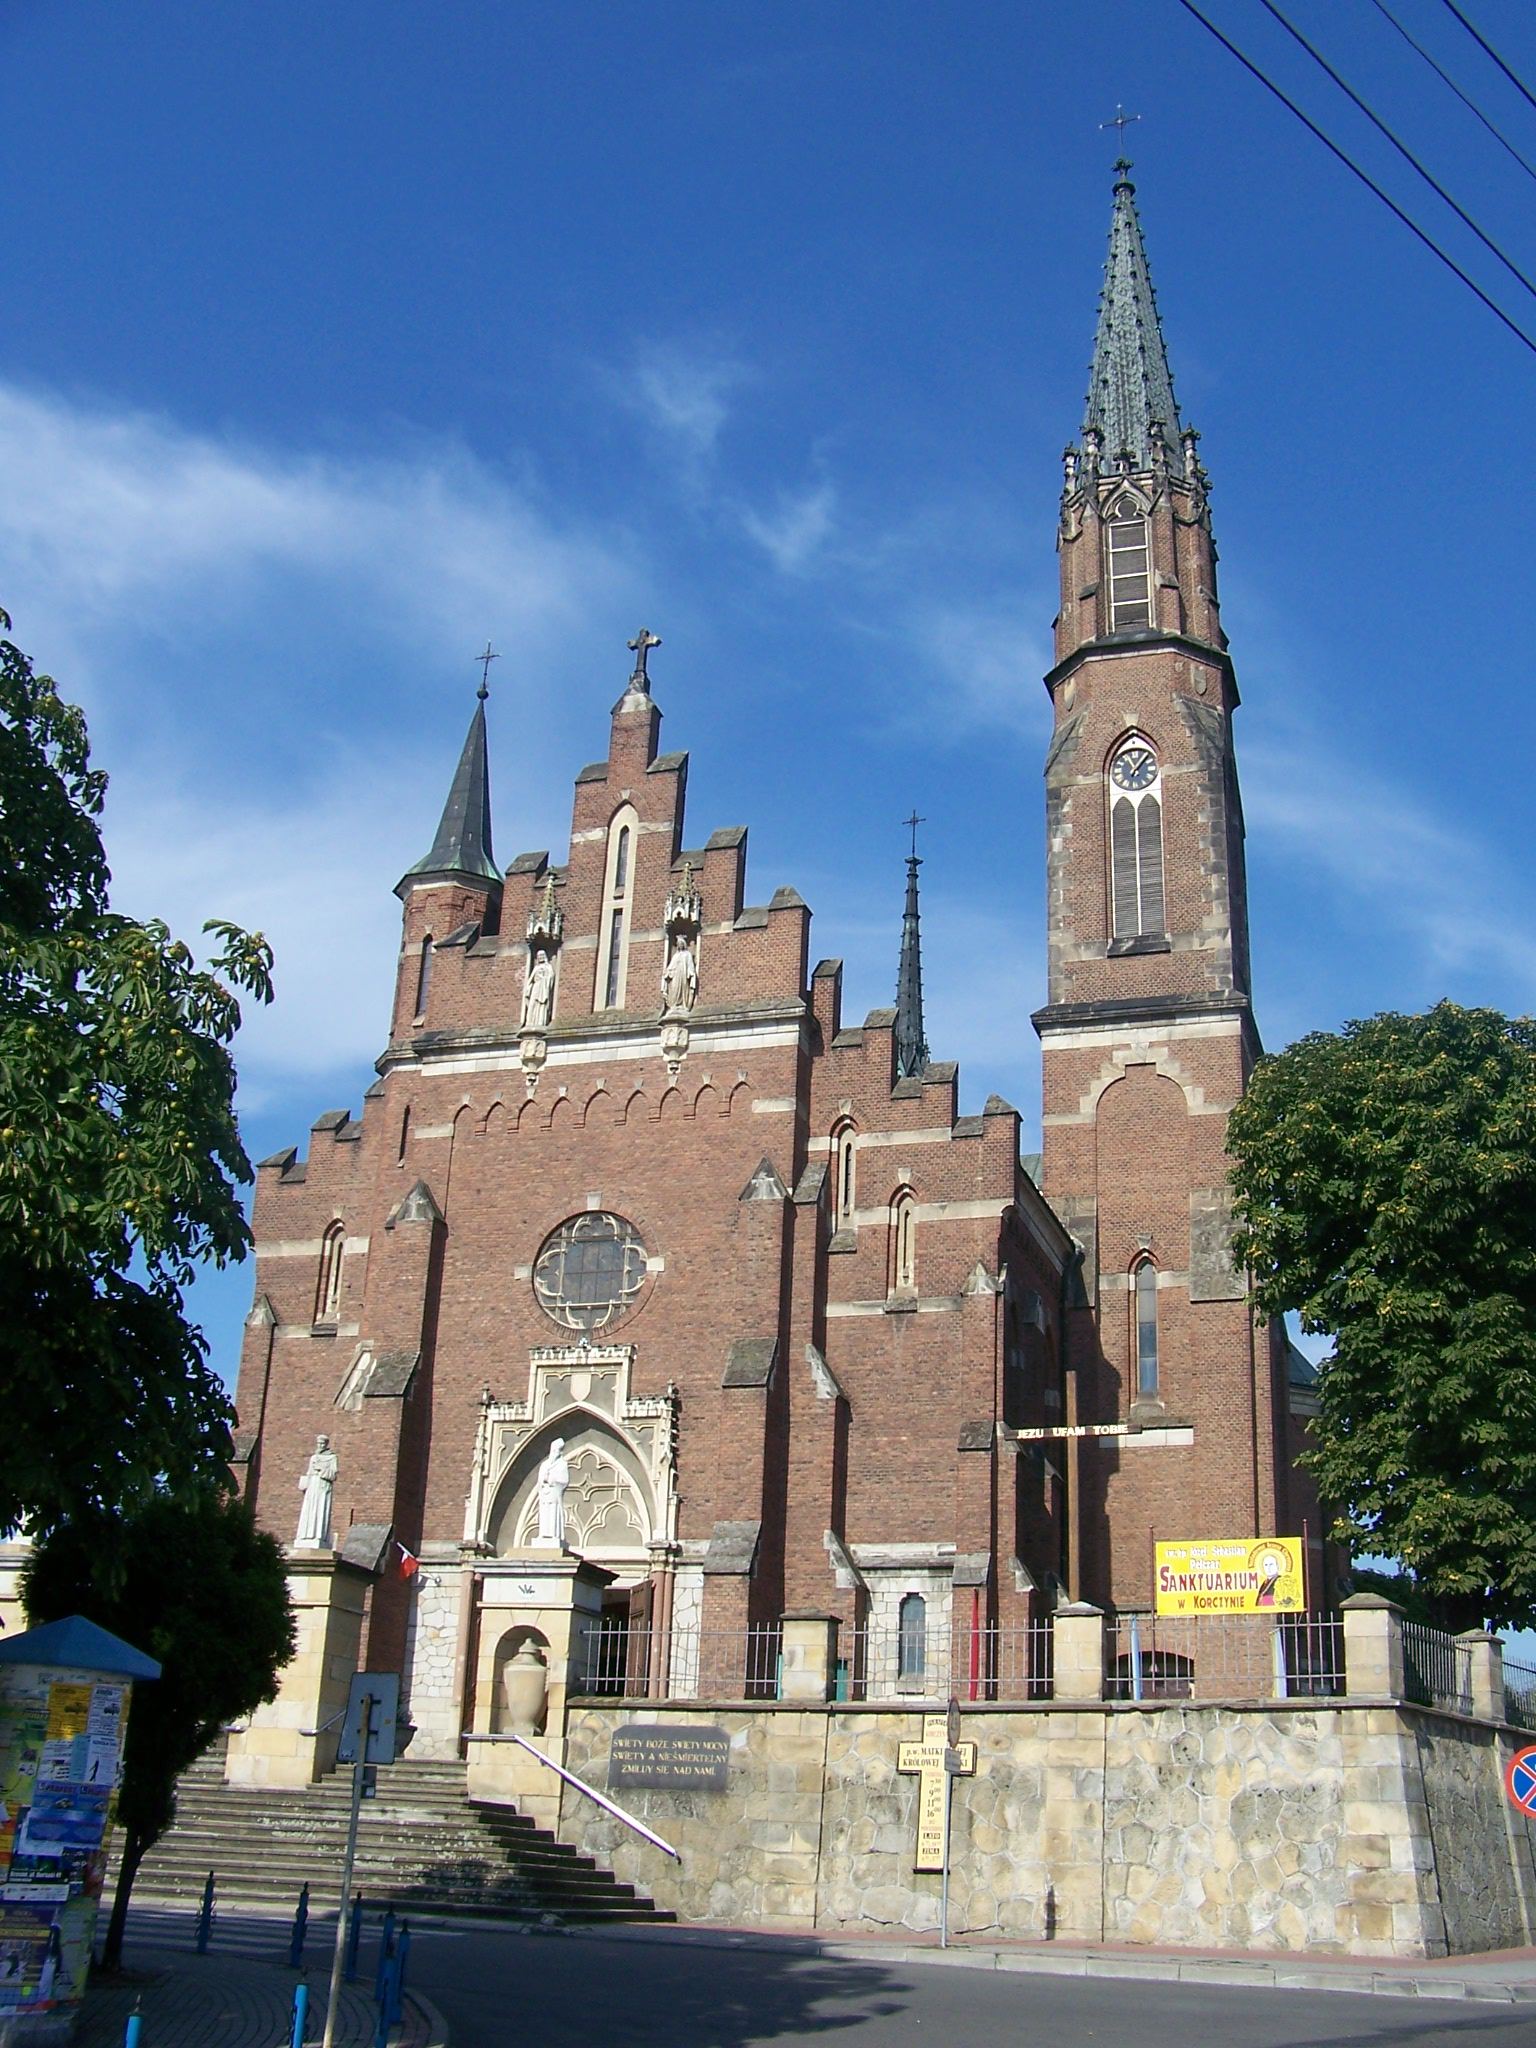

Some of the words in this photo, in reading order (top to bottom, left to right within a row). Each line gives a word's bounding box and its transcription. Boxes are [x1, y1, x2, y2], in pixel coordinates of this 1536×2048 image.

[1017, 1428, 1044, 1439] JEZU
[1053, 1426, 1086, 1437] UFAM
[1093, 1424, 1129, 1435] TOBIE
[1160, 1566, 1259, 1592] SANKTUARIUM
[1193, 1595, 1245, 1609] KORCZYNIE
[921, 1747, 943, 1756] MATKI
[673, 1765, 692, 1776] NAD
